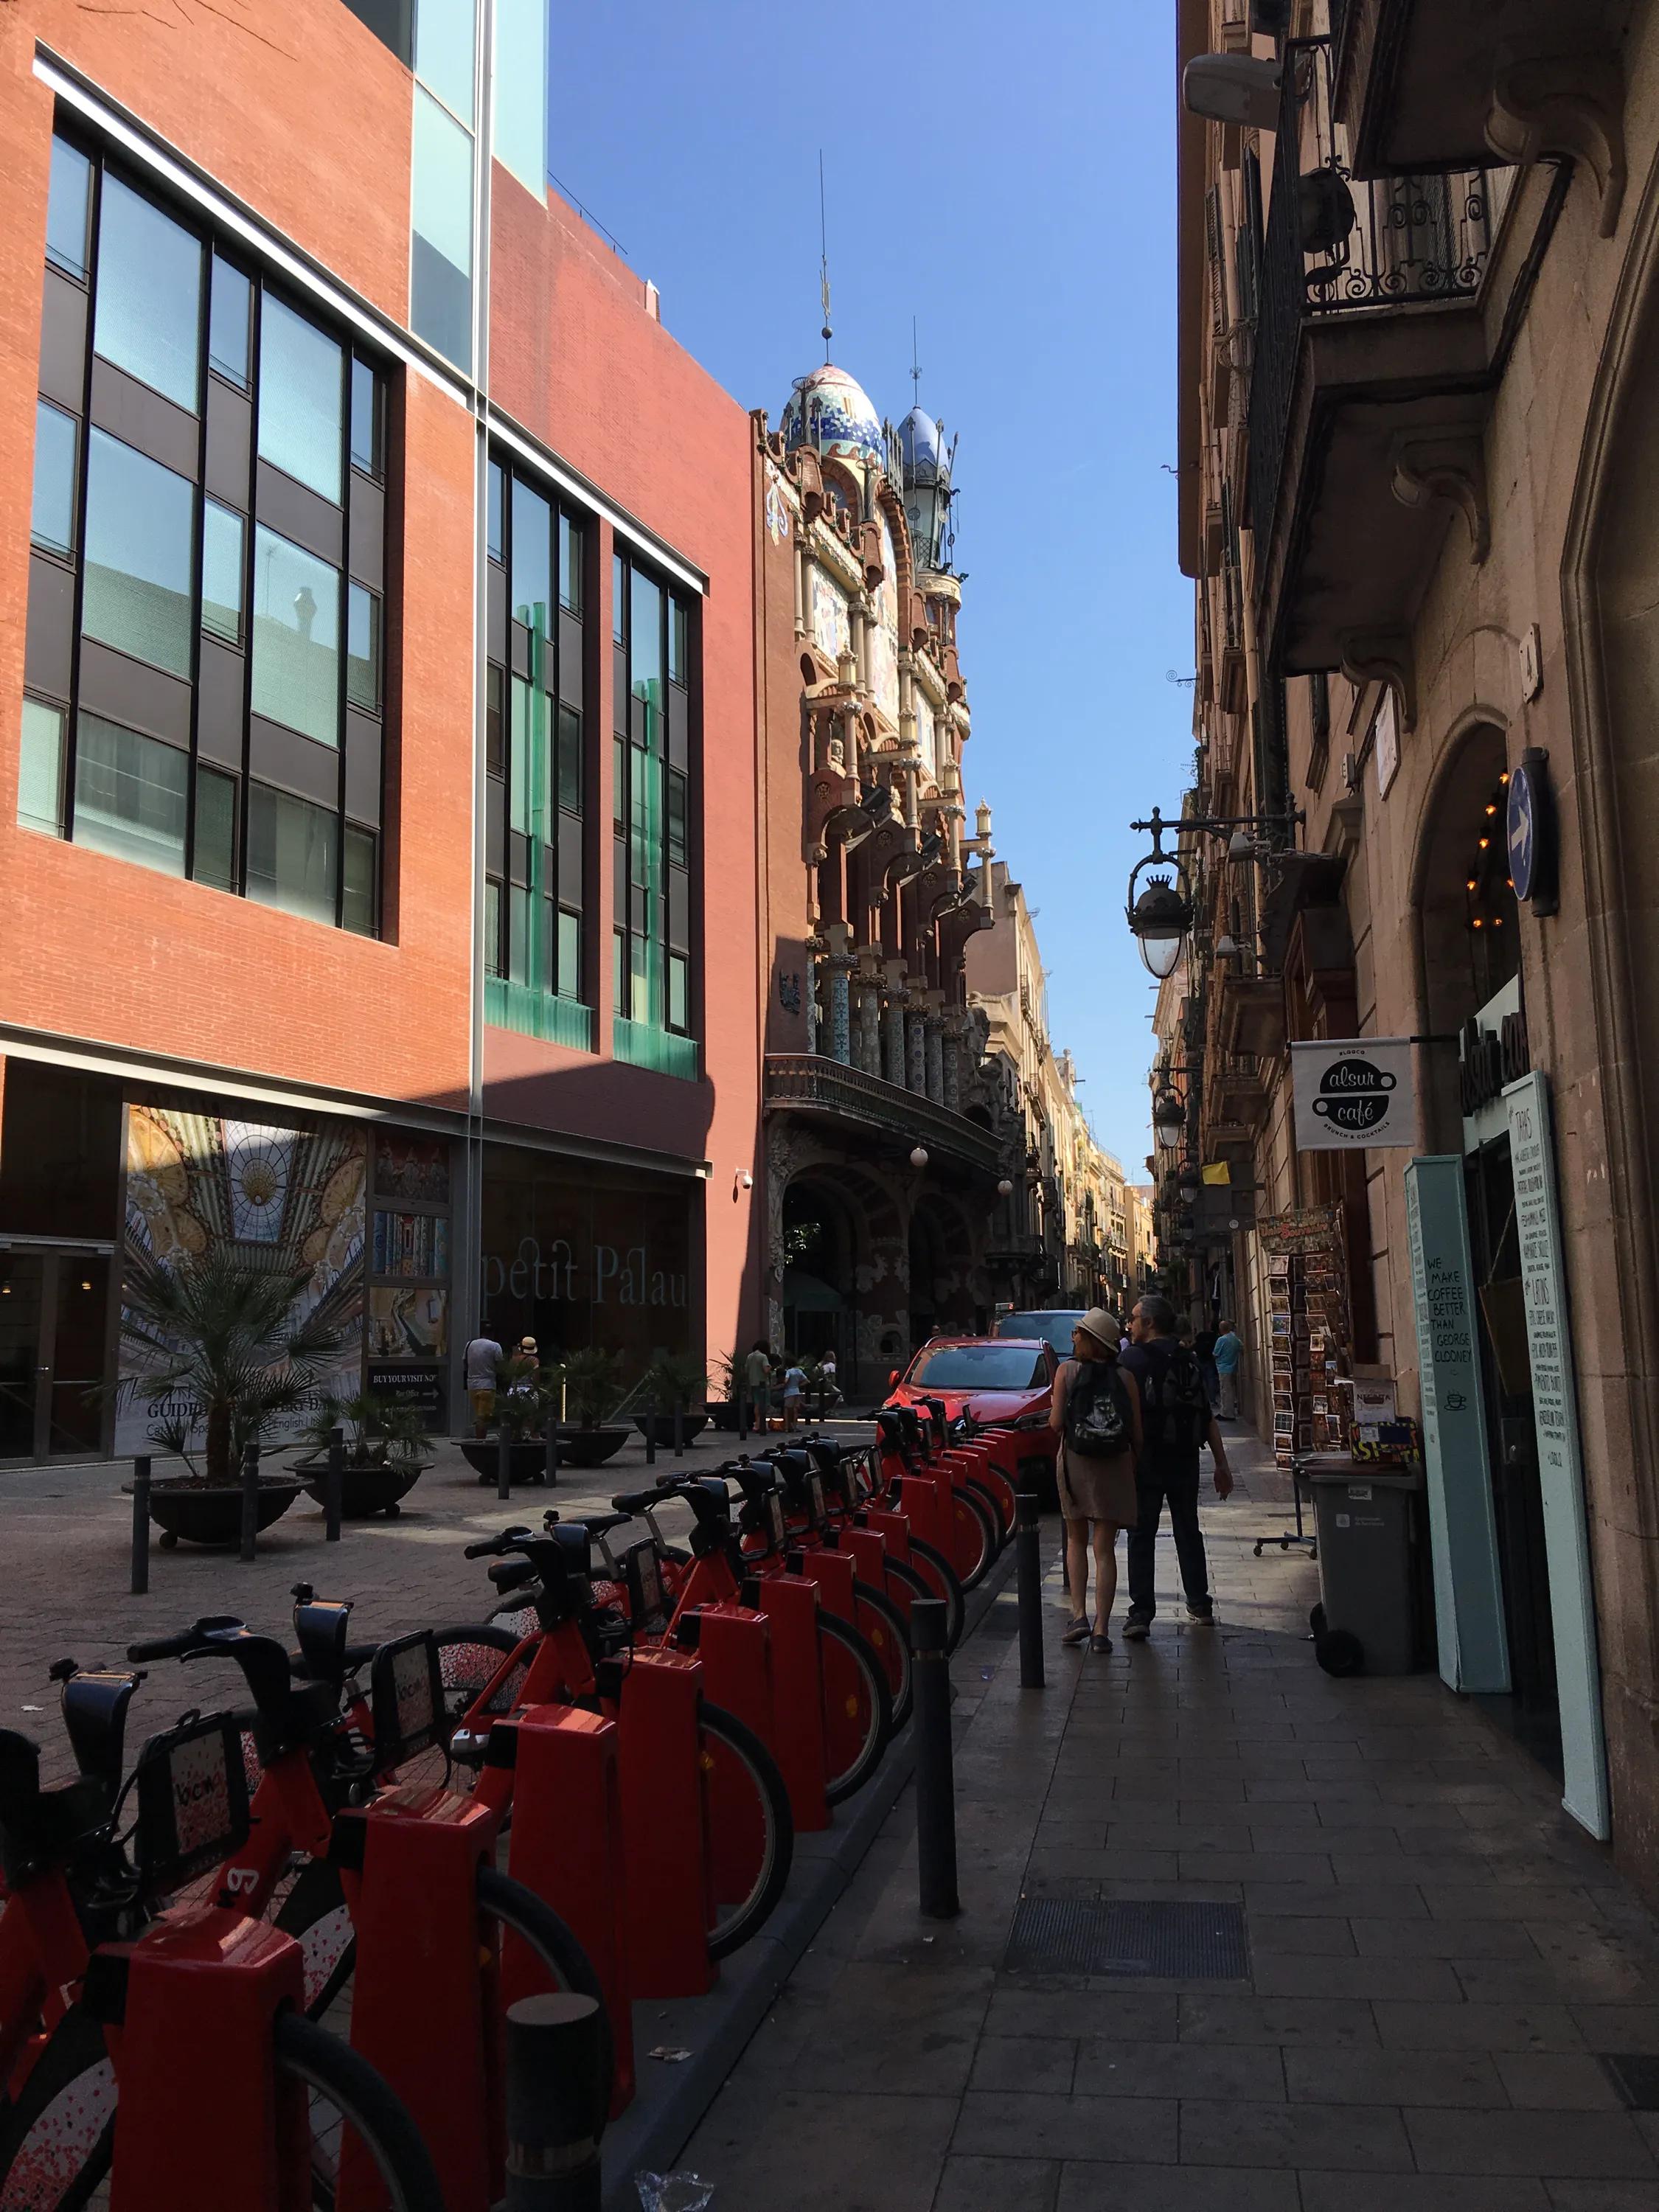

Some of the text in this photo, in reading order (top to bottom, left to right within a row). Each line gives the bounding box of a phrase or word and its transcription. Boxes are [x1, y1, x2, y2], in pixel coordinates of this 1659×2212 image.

[1329, 1065, 1375, 1088] alsur
[1337, 1099, 1374, 1126] café
[1323, 1123, 1349, 1138] BRUNCH
[1357, 1121, 1391, 1139] COCKTAILS
[1427, 1257, 1441, 1269] WE
[480, 1236, 689, 1322] petit Palau
[1431, 1270, 1460, 1284] MAKE
[1427, 1287, 1464, 1301] COFFEE
[1433, 1302, 1466, 1316] BETTER
[1430, 1318, 1454, 1331] THAN
[1436, 1333, 1471, 1346] GEORGE
[1434, 1349, 1472, 1363] CLOONEY
[372, 1374, 387, 1384] BUY
[388, 1374, 406, 1384] YOUR
[406, 1374, 423, 1383] VISIT
